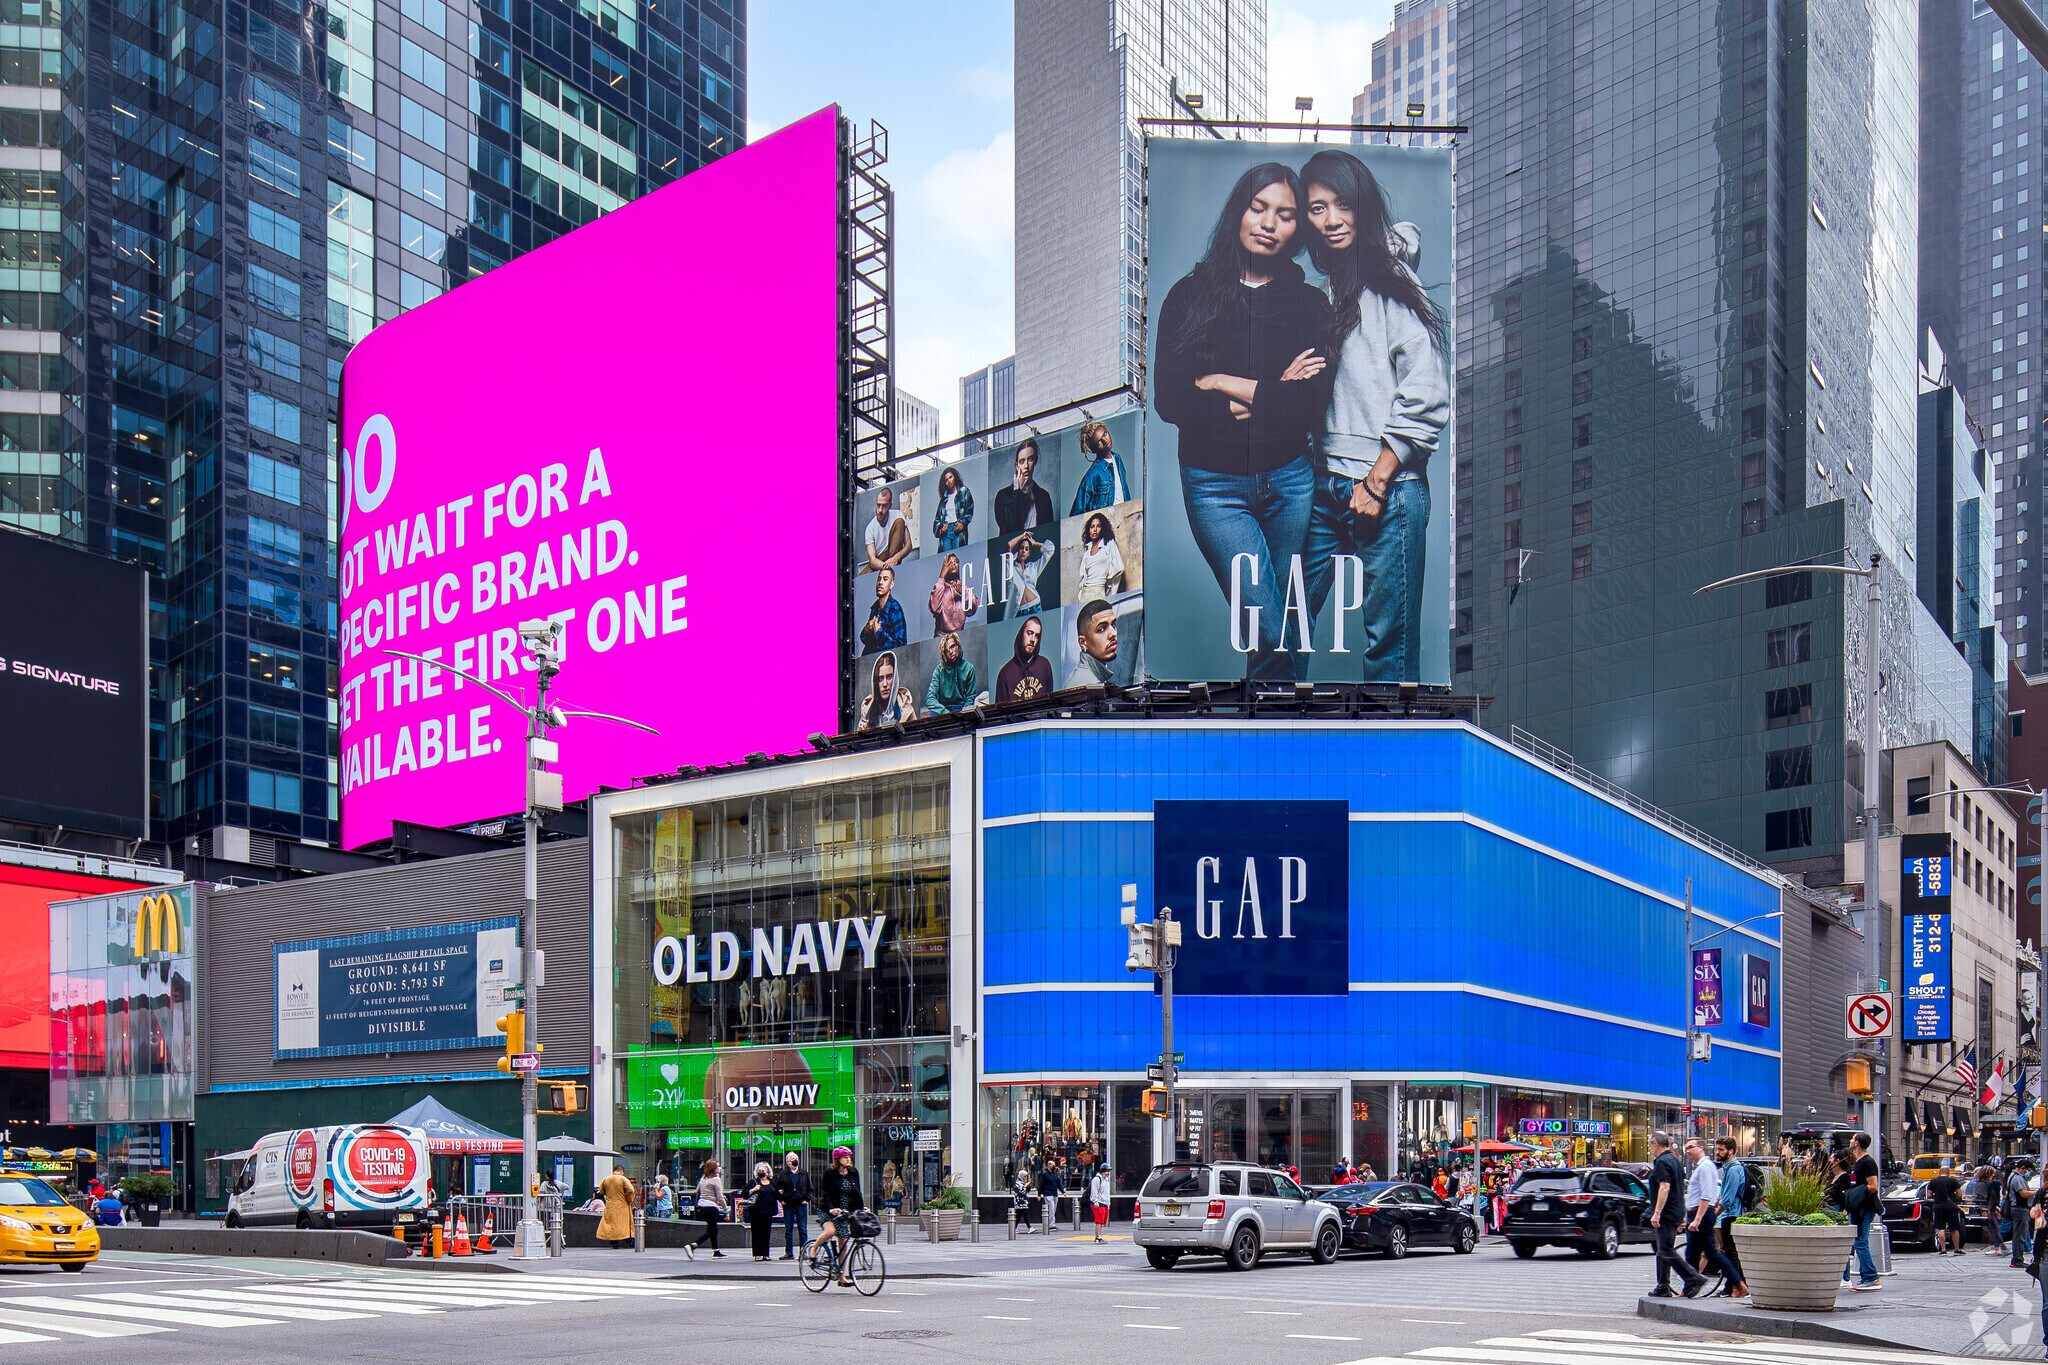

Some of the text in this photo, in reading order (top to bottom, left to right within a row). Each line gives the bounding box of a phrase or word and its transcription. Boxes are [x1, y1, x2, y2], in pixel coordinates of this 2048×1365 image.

[340, 447, 612, 599] OT WAIT FOR A
[962, 552, 1014, 611] GAP
[340, 519, 639, 669] PECIFIC BRAND.
[1231, 553, 1364, 652] GAP
[340, 673, 365, 736] ET
[370, 647, 443, 712] THE
[586, 575, 688, 653] ONE
[12, 661, 119, 695] SIGNATURE
[340, 704, 502, 797] VAILABLE.
[481, 823, 502, 836] PRIME
[1196, 856, 1307, 939] GAP
[329, 945, 468, 967] LAST REMAINING FLAGSHIP RETAIL SPACE
[653, 915, 887, 986] OLD NAVY
[1913, 937, 1923, 968] RENT
[348, 959, 447, 980] GROUND: 8,641 SF
[349, 976, 445, 995] SECOND: 5,793 SF
[1752, 974, 1767, 1008] GAP
[1909, 986, 1945, 995] SHOUT
[371, 997, 387, 1005] FEET
[397, 994, 430, 1003] FRONTAGE
[333, 1012, 348, 1020] FEET
[358, 1007, 423, 1018] HEIGHT-STOREFRONT
[424, 1005, 438, 1013] AND
[438, 1003, 468, 1012] SIGNAGE
[368, 1020, 426, 1035] DIVISIBLE
[725, 1084, 819, 1108] OLD NAVY
[1526, 1120, 1563, 1132] GYRO
[295, 1147, 313, 1161] COVID-19
[360, 1147, 406, 1161] COVID-19
[428, 1140, 503, 1151] VID-19 TESTING
[265, 1151, 279, 1164] CTS
[294, 1161, 312, 1175] TESTING
[362, 1162, 405, 1176] TESTING
